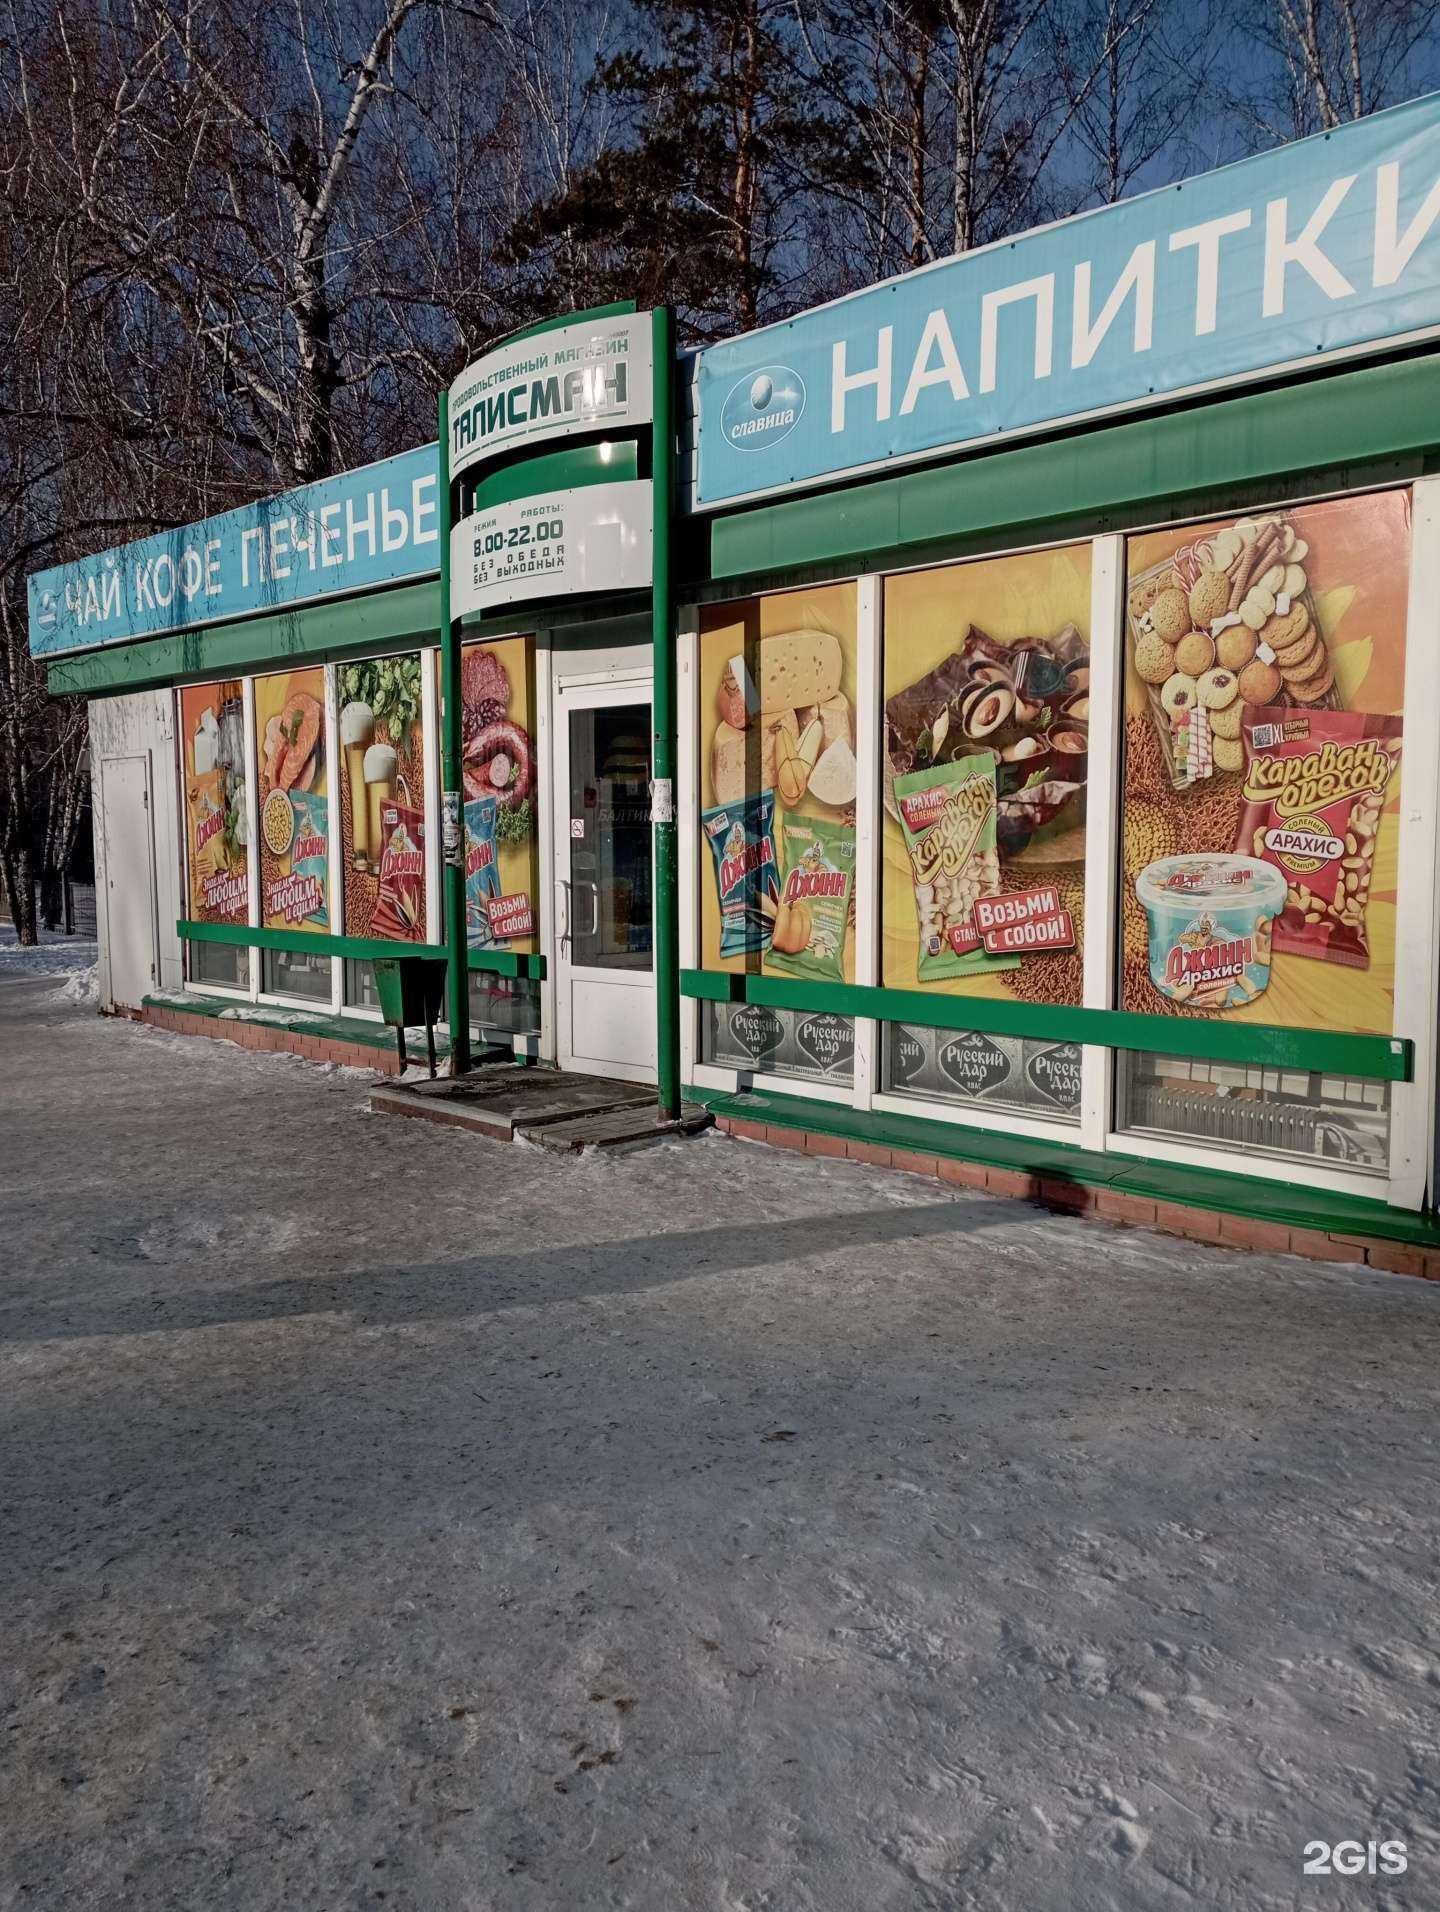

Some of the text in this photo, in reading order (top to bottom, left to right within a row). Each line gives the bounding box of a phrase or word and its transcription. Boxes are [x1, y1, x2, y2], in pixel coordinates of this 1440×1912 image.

[831, 162, 1440, 433] НАПИТКИ
[452, 353, 548, 410] ПРОДОВОЛЬСТВЕННЫЙ
[453, 362, 627, 454] ТАЛИСМАН
[730, 405, 795, 440] славица
[474, 504, 564, 533] РЕЖИМ РАБОТЫ:
[65, 473, 438, 625] ЧАЙ КОФЕ ПЕЧЕНЬЕ
[473, 519, 564, 558] 8.00-22.00
[473, 545, 564, 574] БЕЗ ОБЕДА
[473, 556, 564, 584] БЕЗ ВЫХОДНЫХ
[1273, 723, 1285, 744] XL
[1248, 741, 1378, 789] Караван
[1280, 753, 1389, 808] орехов
[906, 791, 942, 813] АРАХИС
[1272, 833, 1337, 855] АРАХИС
[720, 837, 773, 897] ДЖИНН
[269, 873, 315, 913] любим
[783, 869, 847, 904] ДЖИНН
[489, 894, 526, 920] Возьми
[502, 911, 532, 933] собой!
[979, 891, 1055, 927] Возьми
[1004, 915, 1066, 946] собой!
[1166, 938, 1253, 982] ДЖИНН
[1178, 962, 1243, 988] Арахис
[735, 1014, 780, 1034] Русский
[803, 1023, 854, 1045] Русский
[947, 1045, 1003, 1068] Русский
